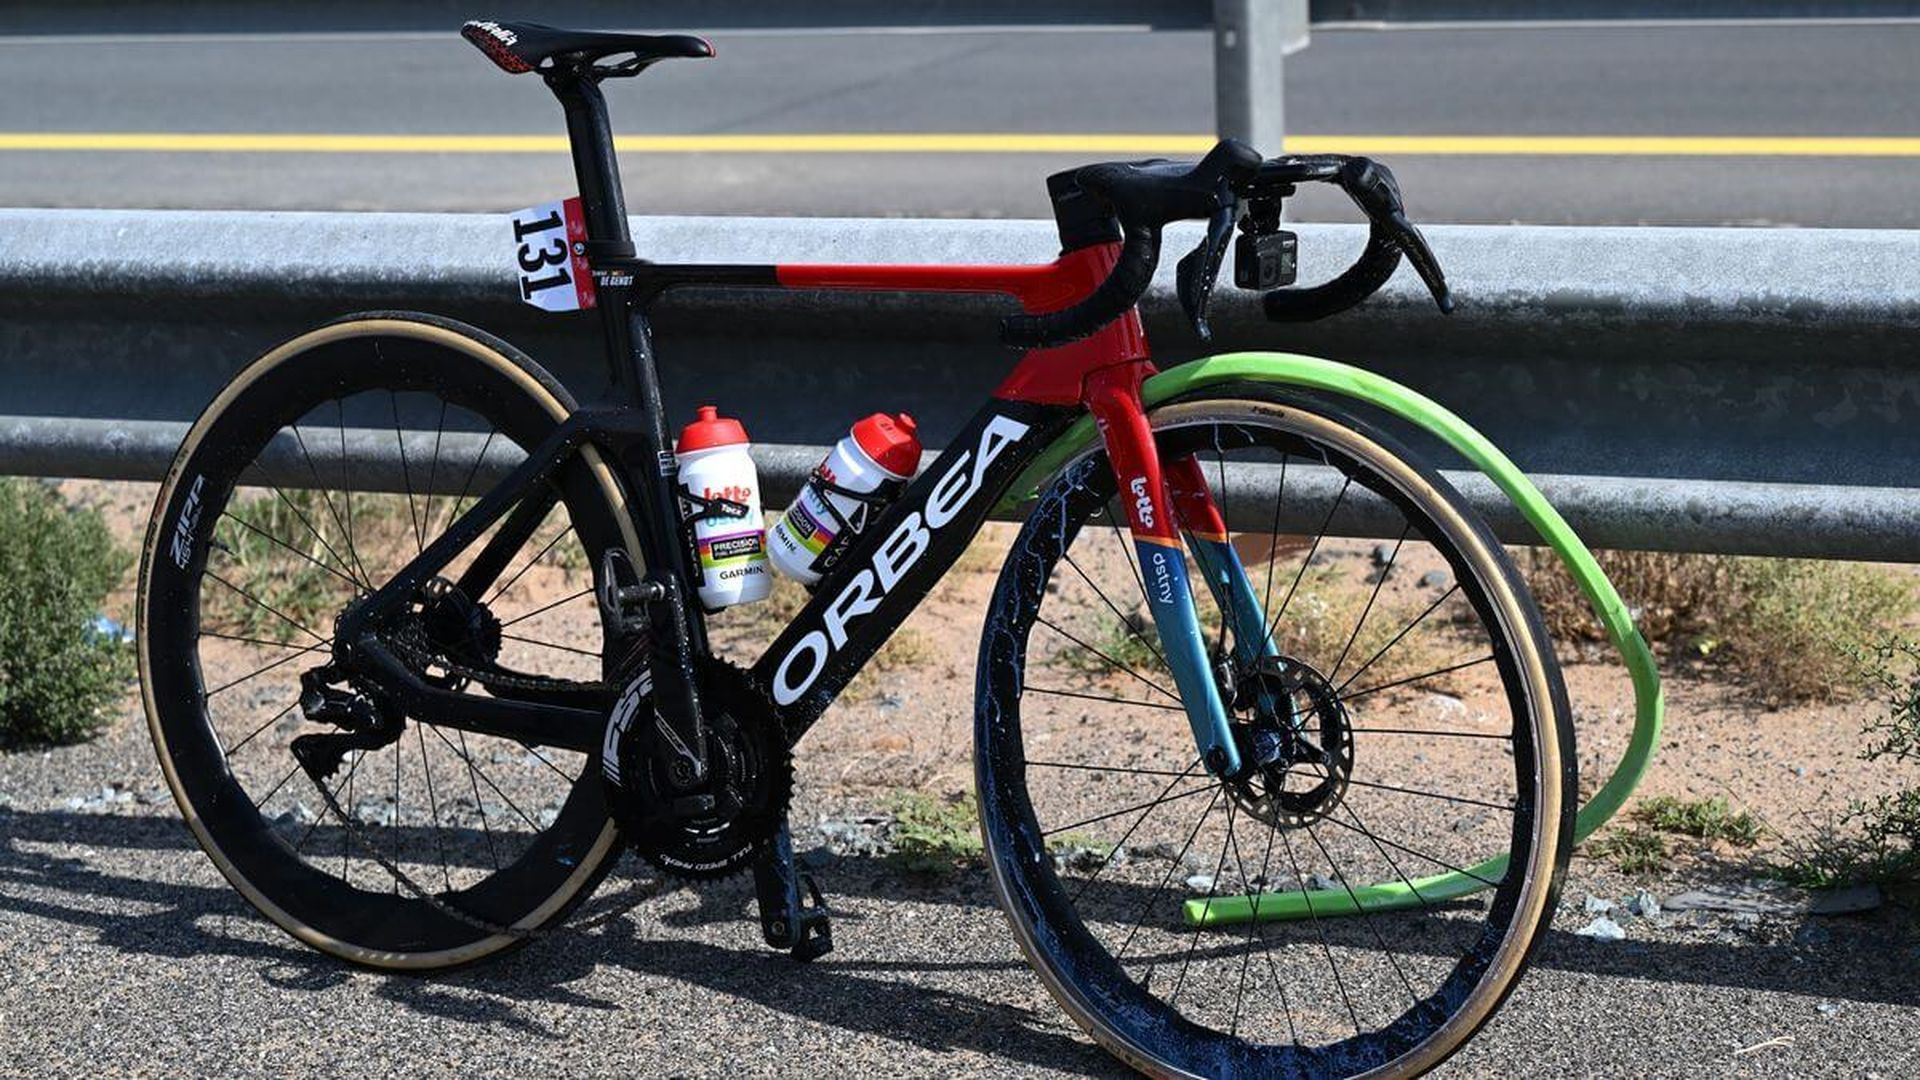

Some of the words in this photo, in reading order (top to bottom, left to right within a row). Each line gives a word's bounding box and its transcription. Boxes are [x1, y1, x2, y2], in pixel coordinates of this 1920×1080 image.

[513, 211, 572, 300] 131
[170, 473, 205, 564] ZIPP
[1131, 476, 1154, 529] lotto
[719, 565, 765, 581] GARMIN
[773, 415, 1030, 706] ORBEA
[1153, 553, 1174, 605] dstny
